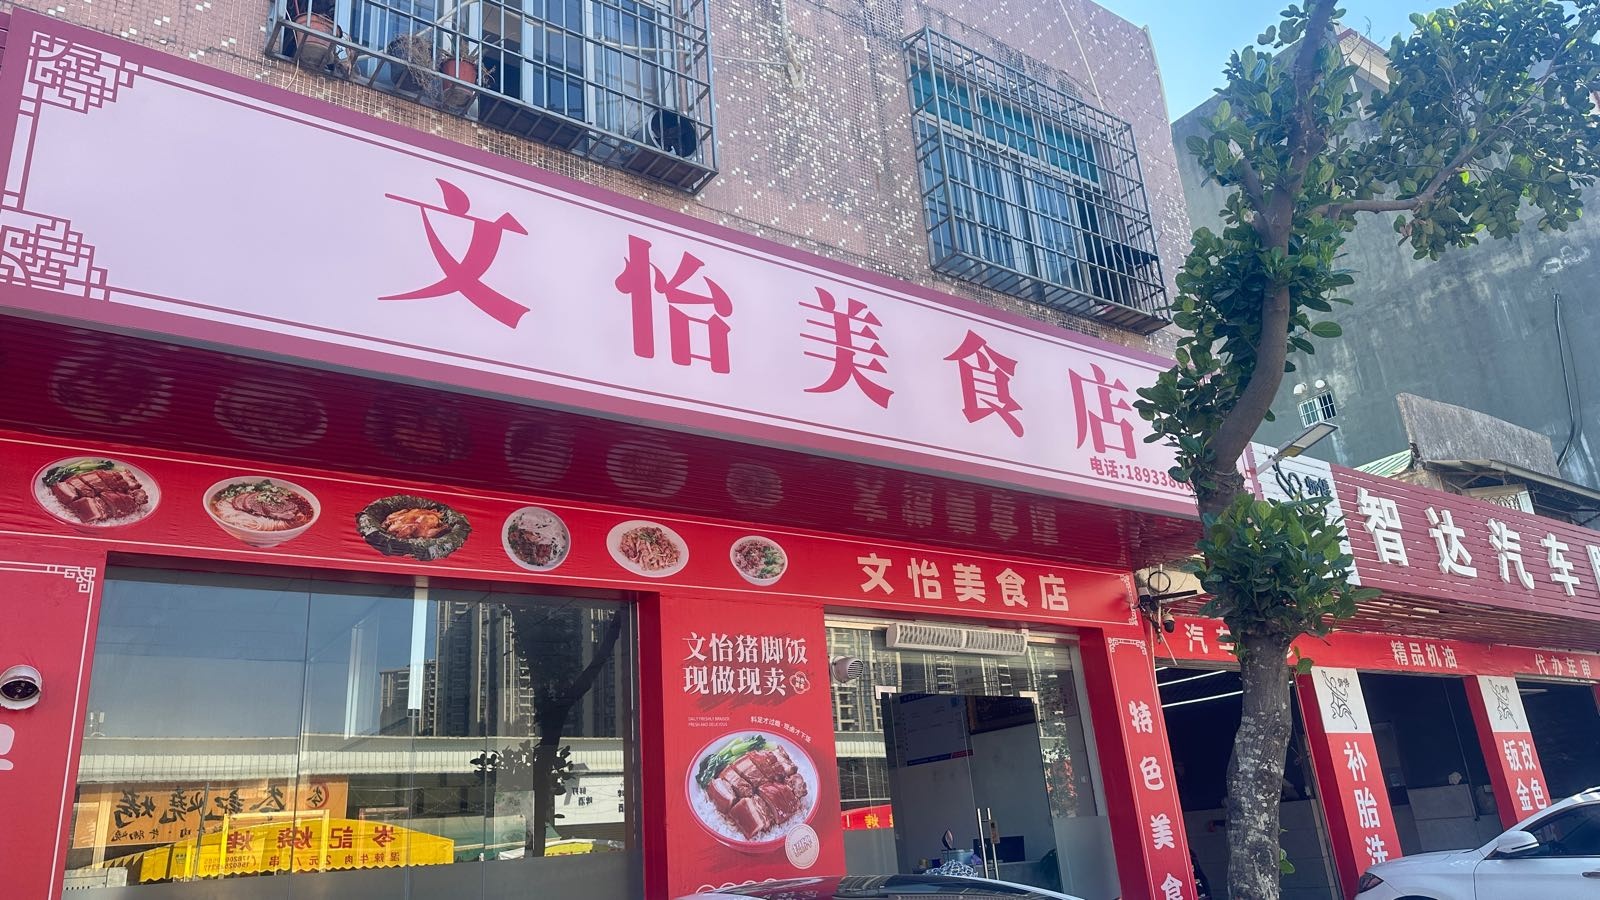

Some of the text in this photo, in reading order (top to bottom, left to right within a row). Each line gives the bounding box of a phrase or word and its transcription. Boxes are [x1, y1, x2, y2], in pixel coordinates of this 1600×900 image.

[378, 178, 1137, 460] 文怡美食店
[857, 553, 1069, 611] 文怡美食店
[682, 632, 808, 664] 文怡猪脚饭
[1390, 640, 1458, 669] 精品机油
[682, 665, 787, 696] 现做现卖
[1535, 653, 1592, 679] 代办年审
[1128, 700, 1183, 900] 特色美食
